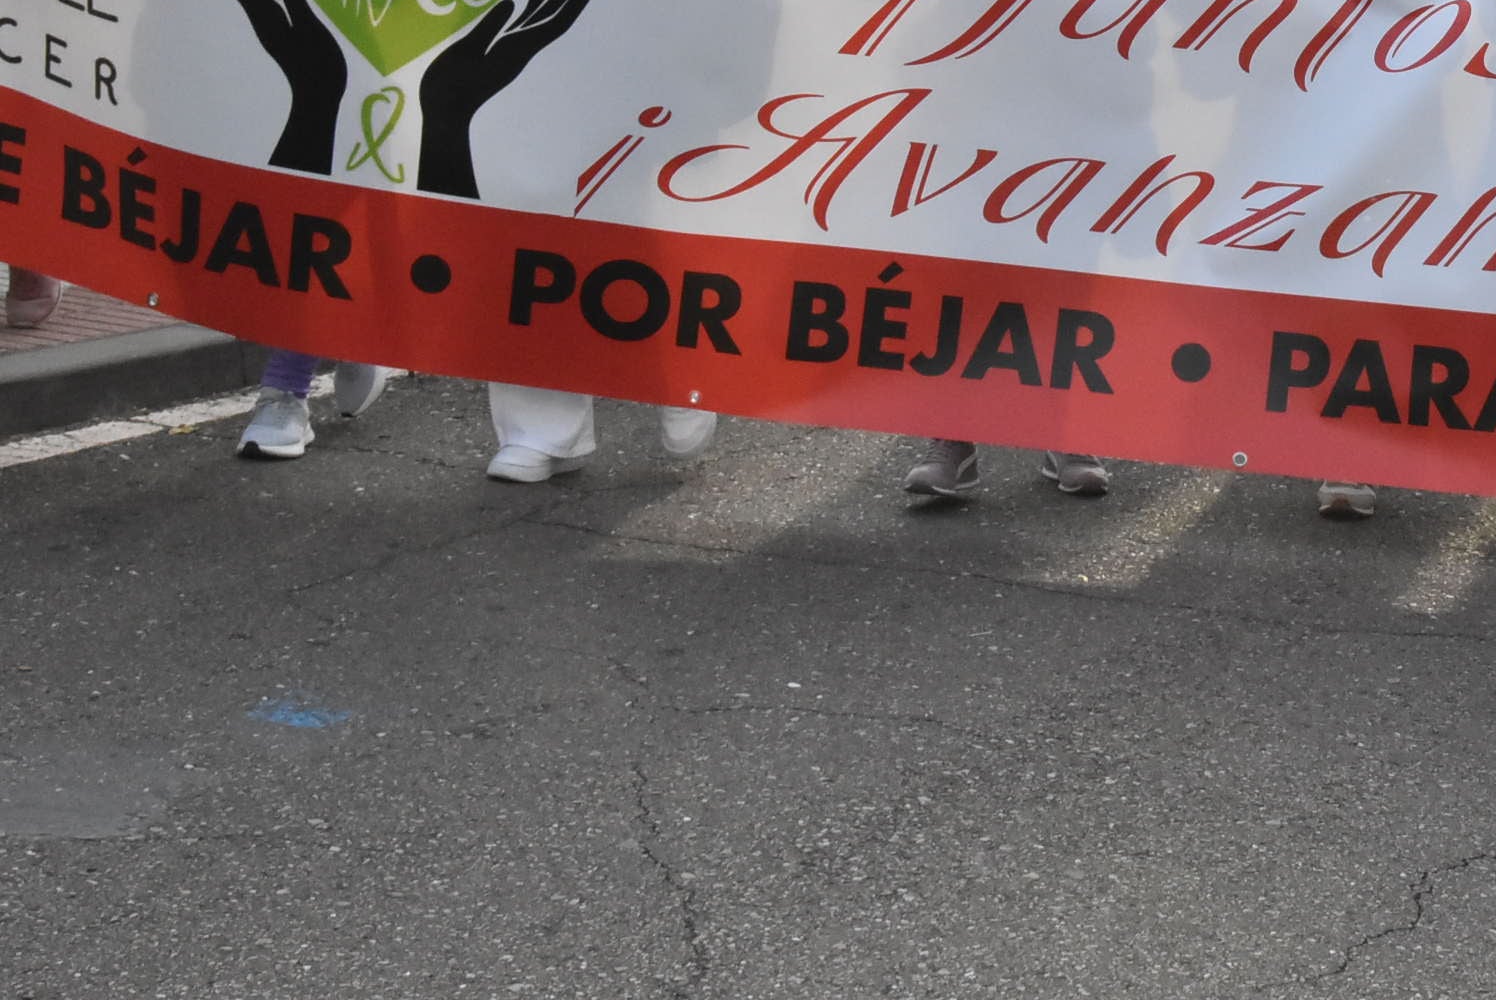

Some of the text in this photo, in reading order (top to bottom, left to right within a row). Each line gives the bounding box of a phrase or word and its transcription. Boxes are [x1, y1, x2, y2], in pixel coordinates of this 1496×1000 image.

[60, 144, 353, 301] BÉJAR
[507, 247, 742, 355] POR
[785, 261, 1116, 395] BÉJAR
